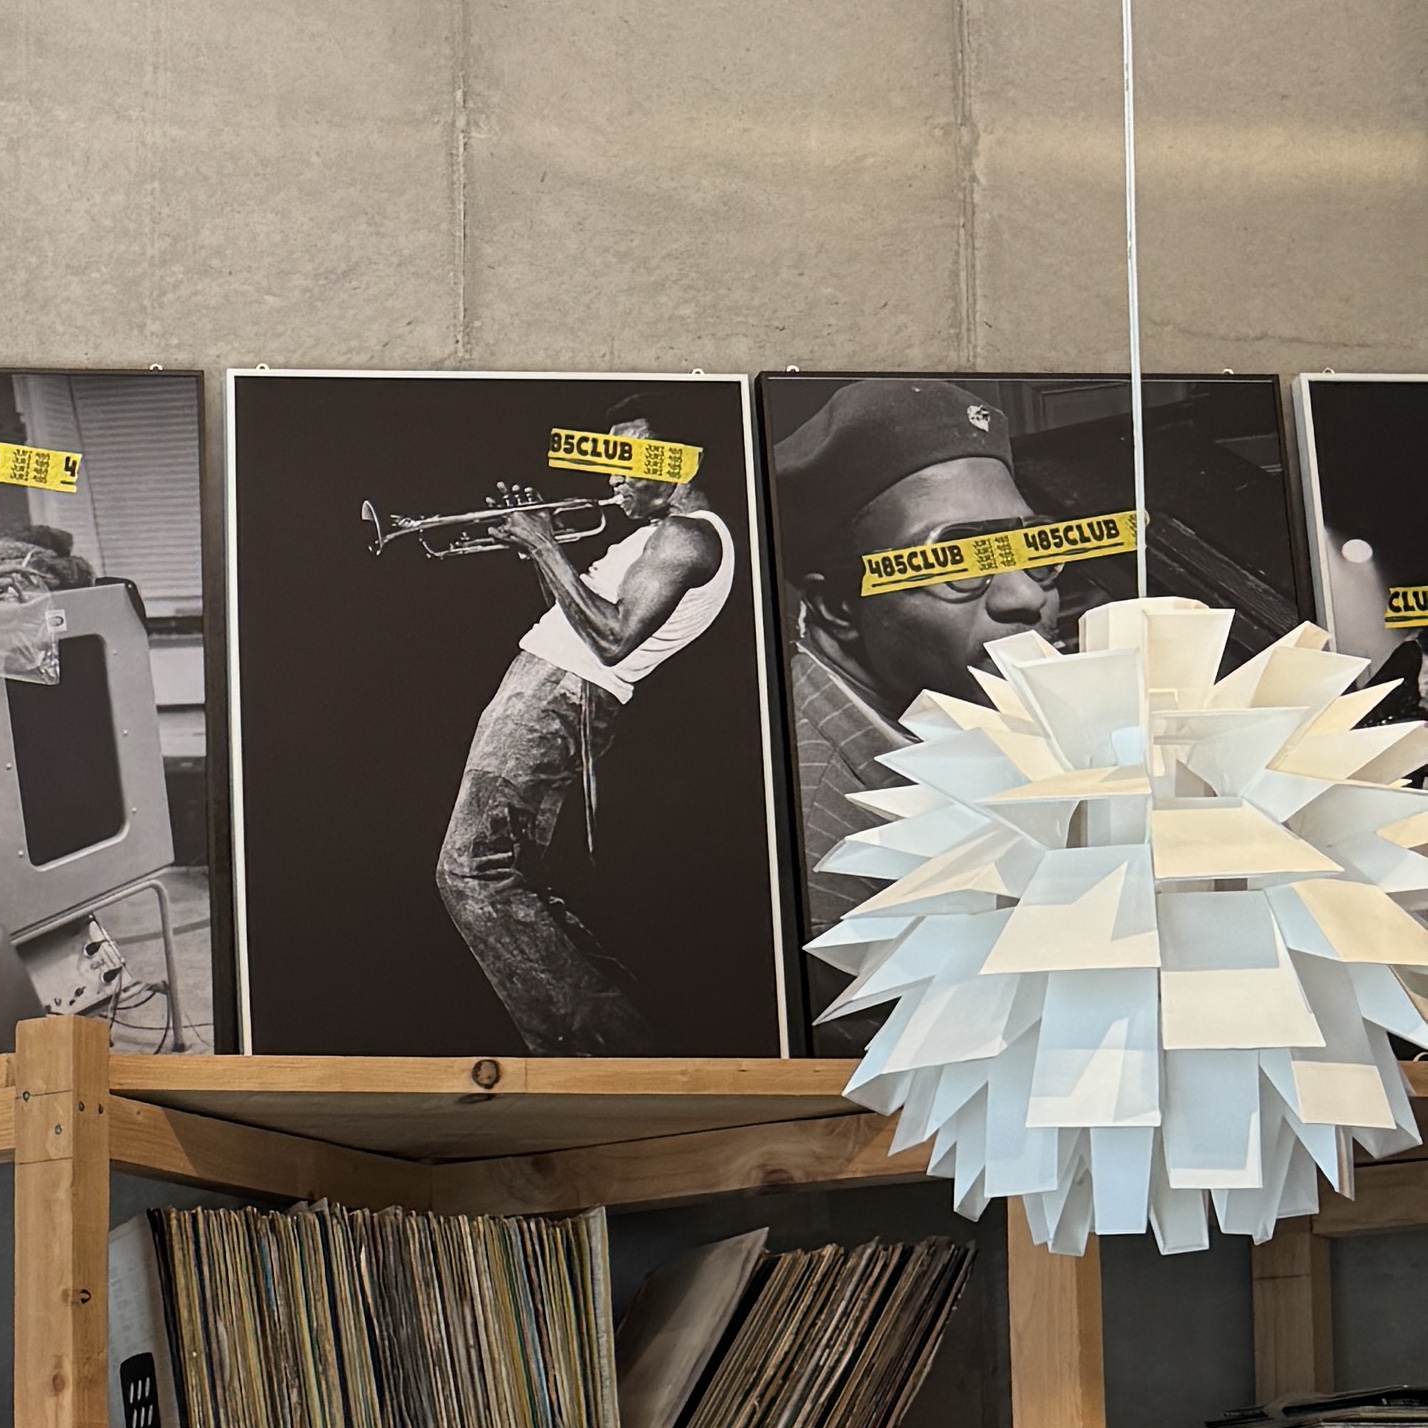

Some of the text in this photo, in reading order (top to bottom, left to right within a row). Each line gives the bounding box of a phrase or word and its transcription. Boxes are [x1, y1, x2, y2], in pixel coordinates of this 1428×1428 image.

[64, 456, 77, 476] 4
[1024, 519, 1120, 551] 485CLUB
[867, 545, 964, 578] 485CLUB
